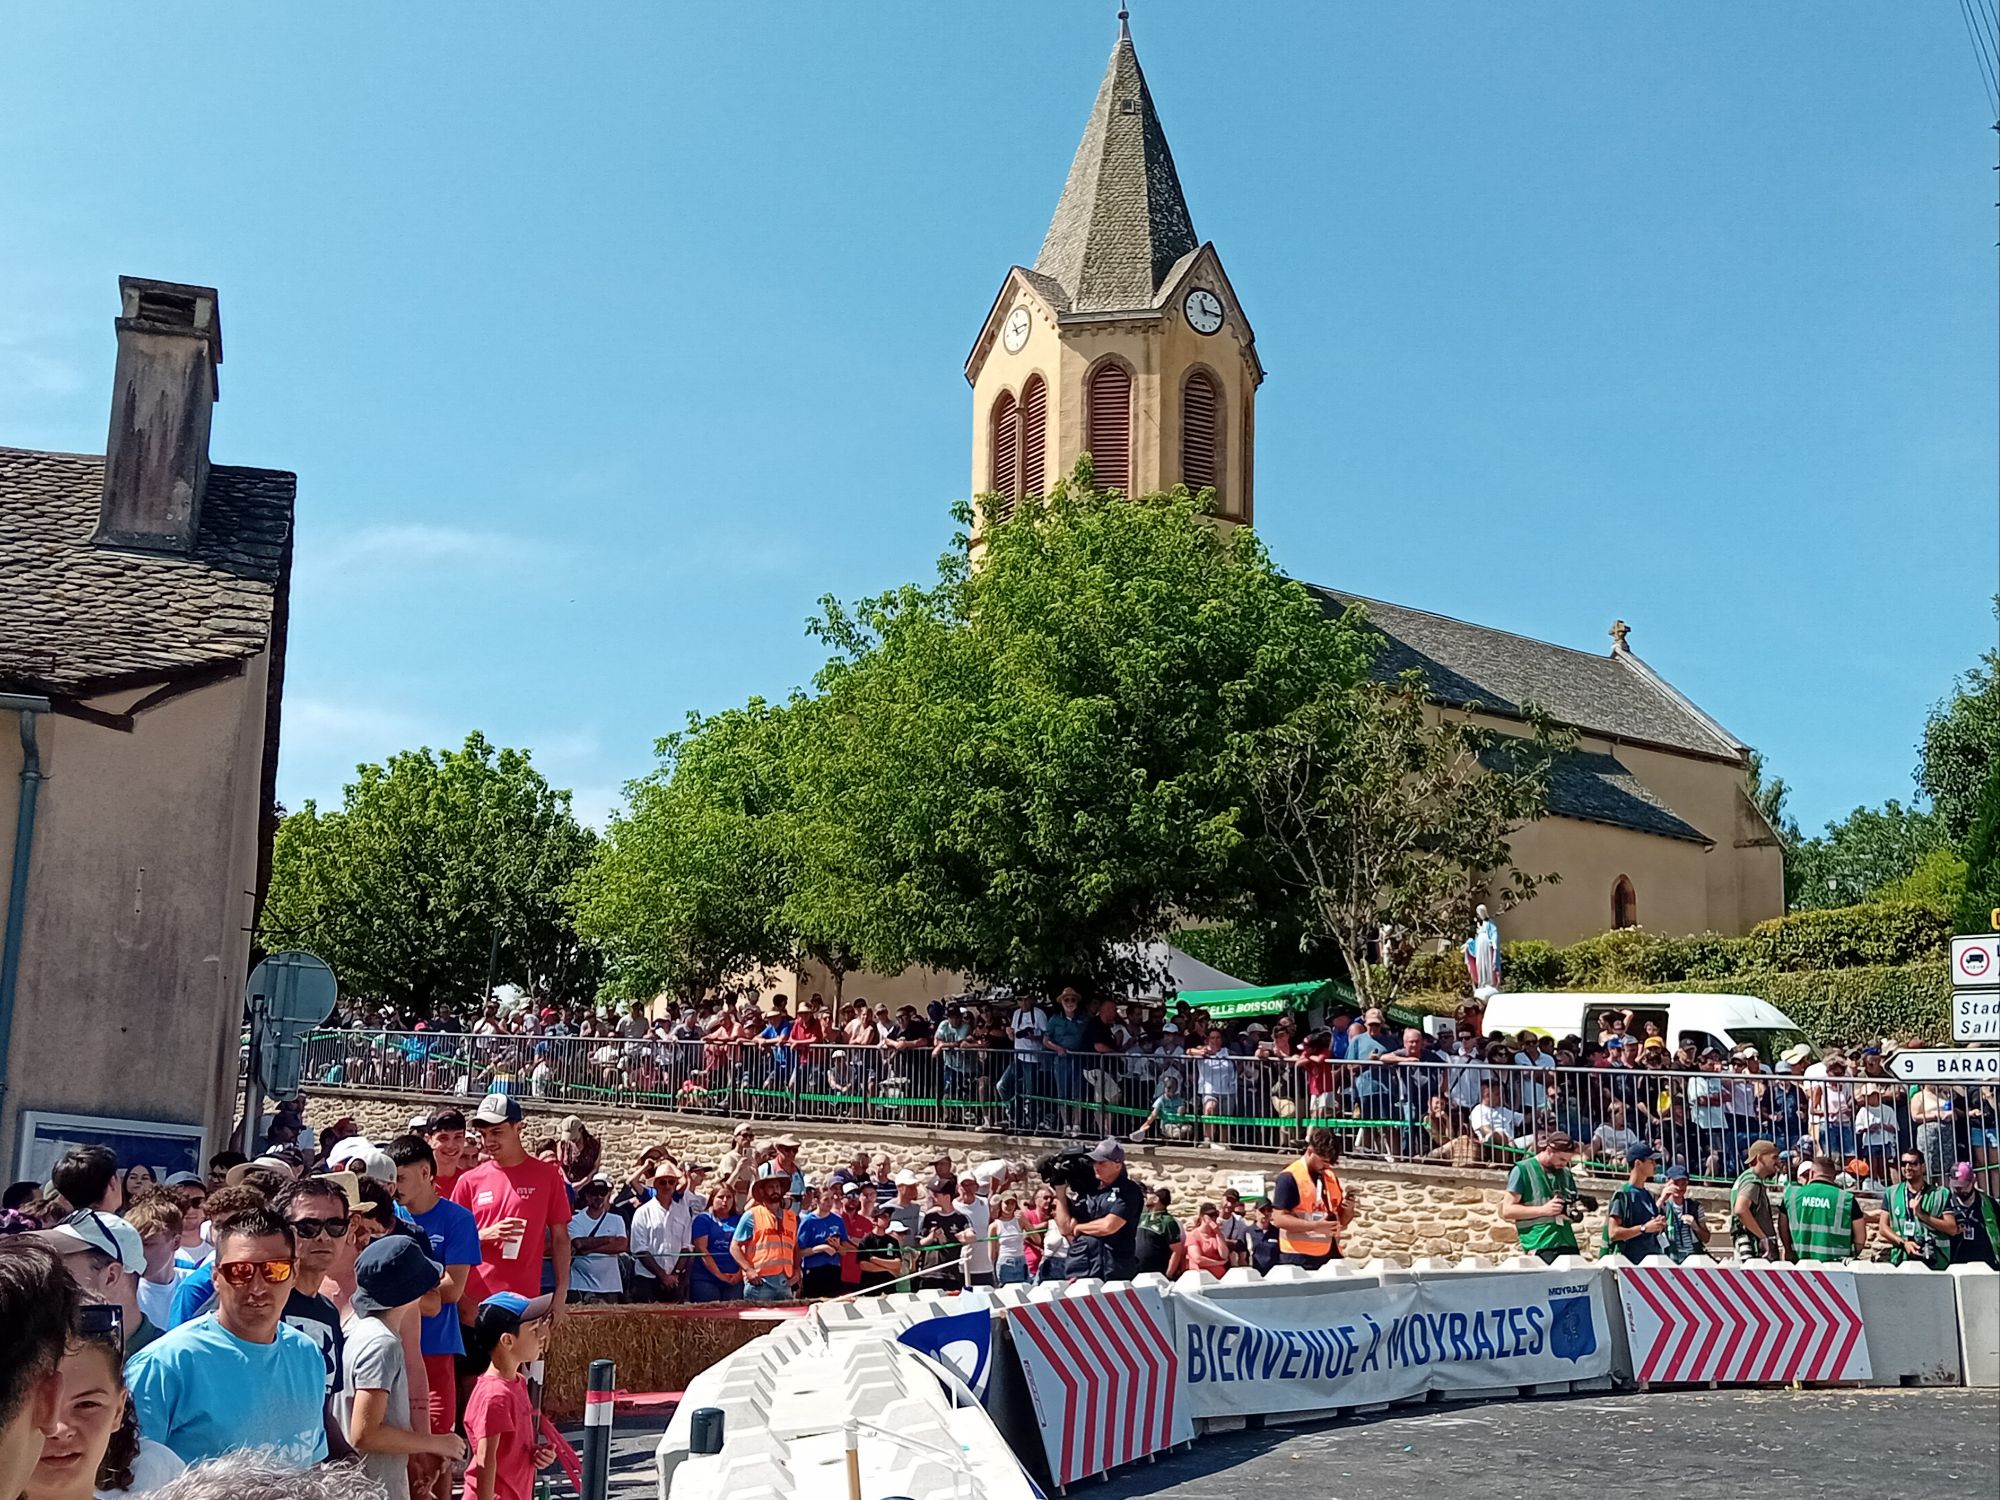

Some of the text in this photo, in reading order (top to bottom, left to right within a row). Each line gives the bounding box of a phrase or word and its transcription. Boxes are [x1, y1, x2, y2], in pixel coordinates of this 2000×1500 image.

[1207, 1004, 1235, 1015] ELLE
[1961, 1020, 1997, 1034] Sall
[1904, 1058, 1998, 1073] 9 BARAQ
[1801, 1196, 1830, 1209] MEDIA
[1186, 1305, 1545, 1384] BIENVENUE À MOYRAZES
